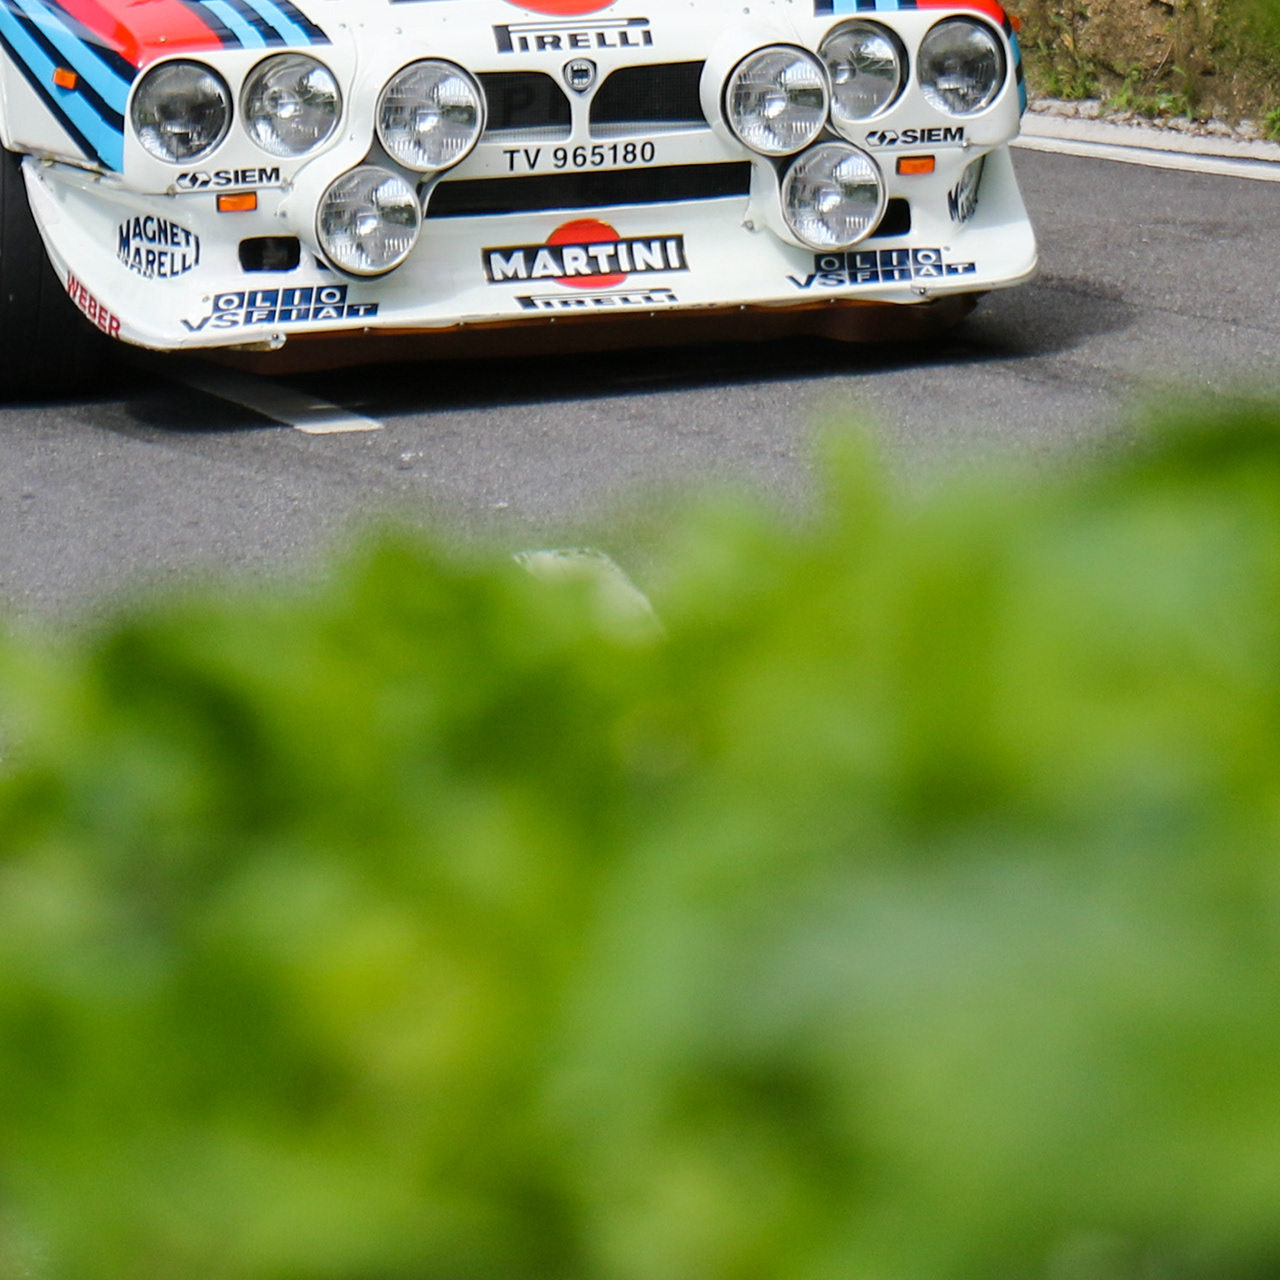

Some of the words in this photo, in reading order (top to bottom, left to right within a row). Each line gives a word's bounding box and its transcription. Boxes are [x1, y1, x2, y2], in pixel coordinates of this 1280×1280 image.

[492, 17, 653, 55] PIRELLI
[900, 127, 965, 144] SIEM
[503, 148, 542, 172] TV
[553, 141, 655, 169] 965180
[211, 167, 280, 187] SIEM
[489, 239, 681, 282] MARTINI
[820, 250, 937, 271] OLIO
[66, 273, 121, 339] WEBER
[217, 286, 341, 311] OLIO
[514, 287, 678, 311] PIRELLI
